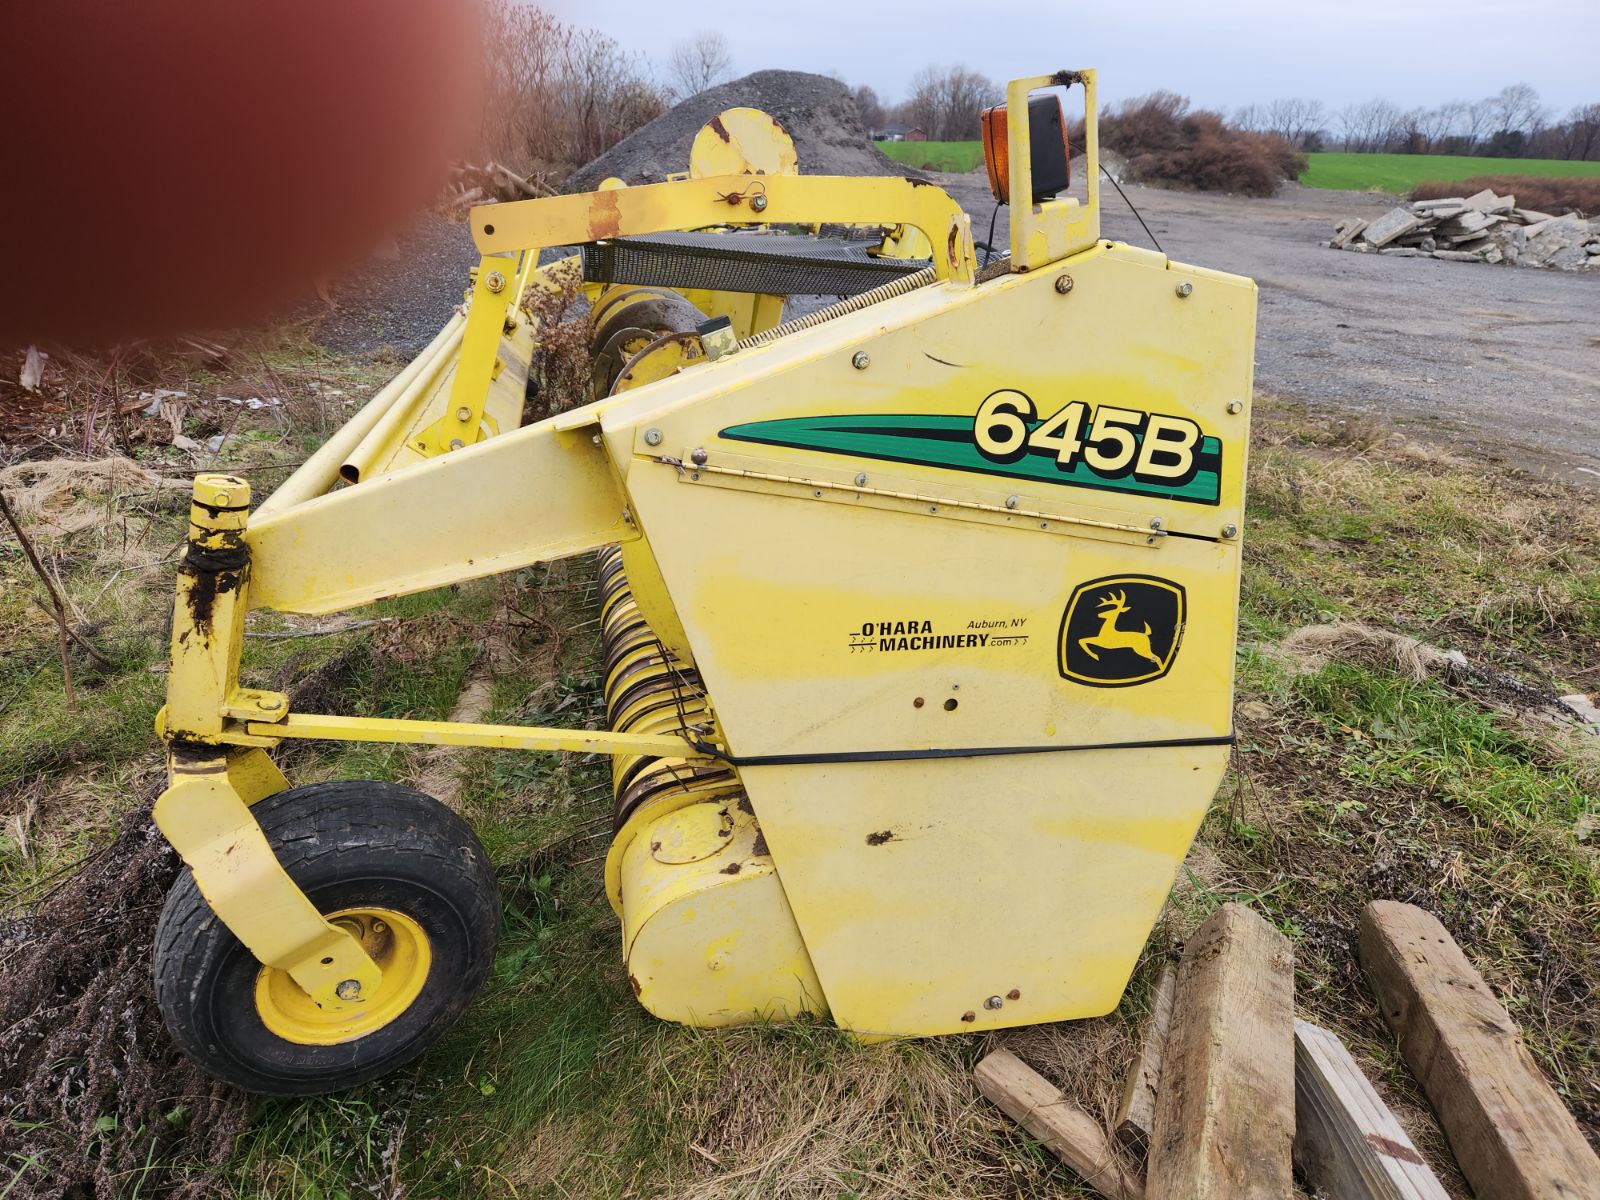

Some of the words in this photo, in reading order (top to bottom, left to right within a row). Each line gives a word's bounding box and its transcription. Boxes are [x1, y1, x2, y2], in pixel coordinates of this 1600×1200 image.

[974, 389, 1203, 487] 645B
[862, 621, 933, 636] O'HARA
[967, 620, 1008, 629] Auburn,
[1010, 618, 1027, 627] NY
